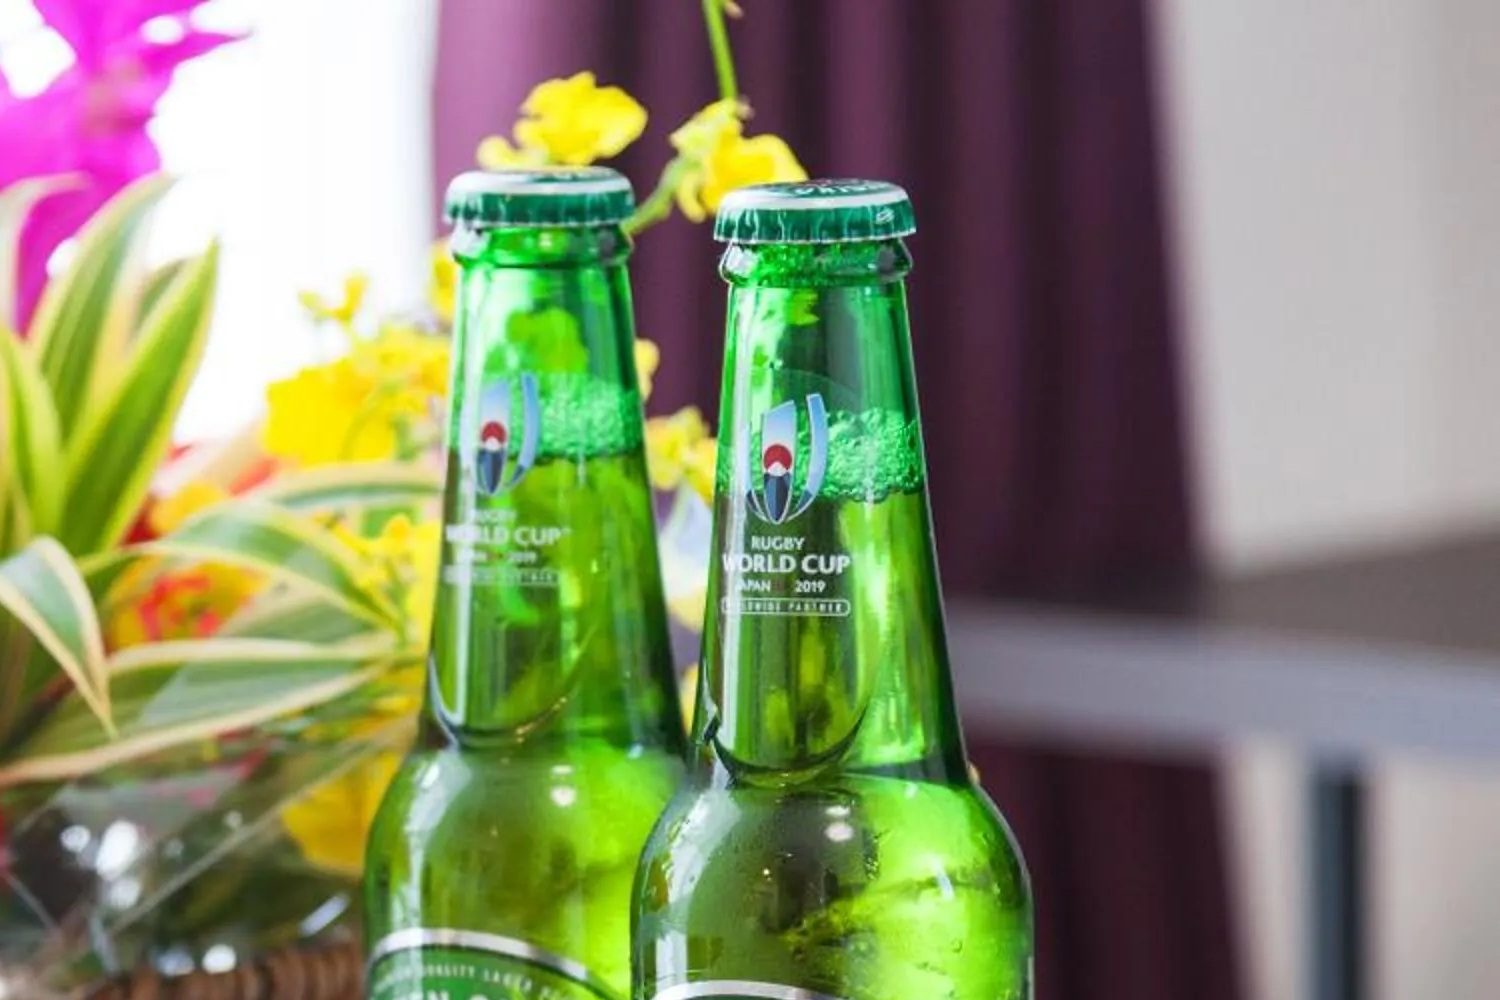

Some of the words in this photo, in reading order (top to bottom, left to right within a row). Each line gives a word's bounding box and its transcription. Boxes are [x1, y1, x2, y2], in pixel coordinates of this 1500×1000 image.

[751, 535, 805, 551] RUGBY
[722, 553, 797, 573] WORLD
[801, 554, 850, 574] CUP
[732, 579, 771, 592] APAN
[794, 579, 827, 593] 2019
